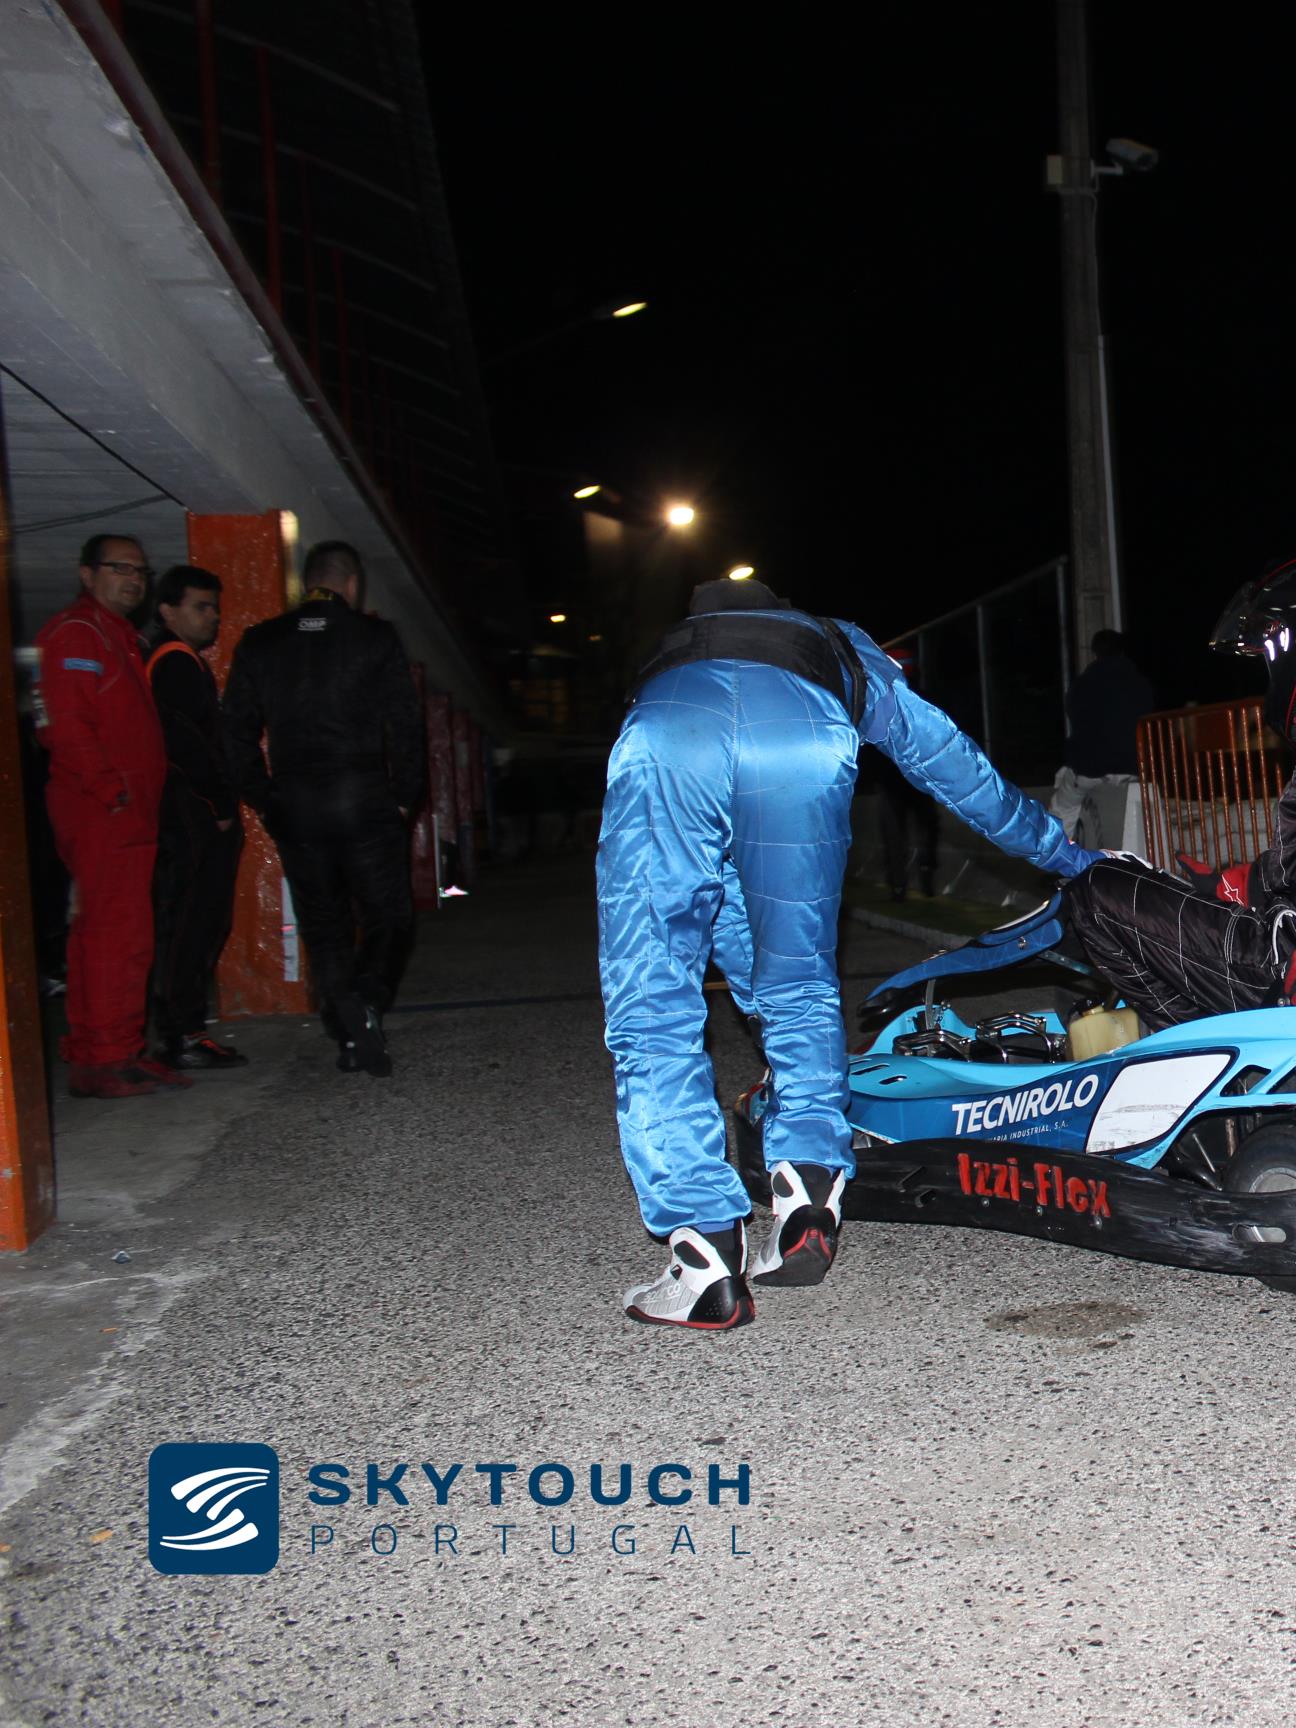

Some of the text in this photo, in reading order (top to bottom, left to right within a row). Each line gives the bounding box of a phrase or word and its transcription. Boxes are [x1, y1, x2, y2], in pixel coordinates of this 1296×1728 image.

[951, 1073, 1100, 1136] TECNIROLO
[1054, 1120, 1069, 1131] S.A.
[956, 1153, 1112, 1218] Izzi-Flex
